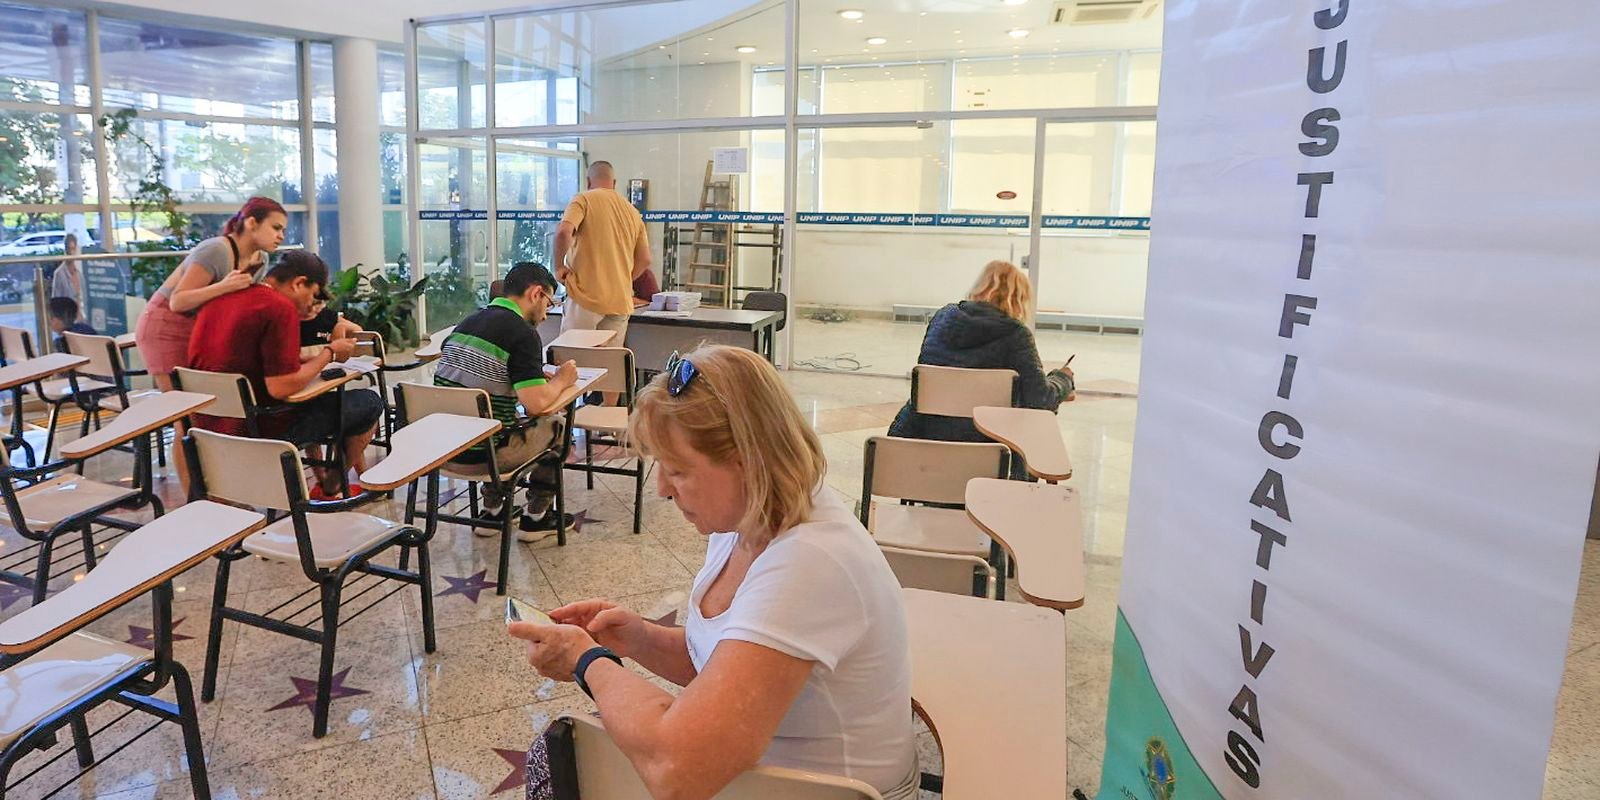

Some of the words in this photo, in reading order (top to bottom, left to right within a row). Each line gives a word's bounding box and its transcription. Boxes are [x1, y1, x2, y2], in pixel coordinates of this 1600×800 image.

[718, 213, 741, 221] UNIP
[767, 214, 785, 222] UNI
[852, 215, 877, 223] UNIP
[880, 215, 905, 223] UNIP
[940, 216, 967, 224] UNIP
[969, 217, 997, 225] UNIP
[999, 217, 1027, 225] UNIP
[1045, 218, 1074, 226] UNIP
[1076, 218, 1106, 226] UNIP
[1108, 219, 1139, 227] UNIP
[1223, 0, 1350, 789] JUSTIFICATIVAS
